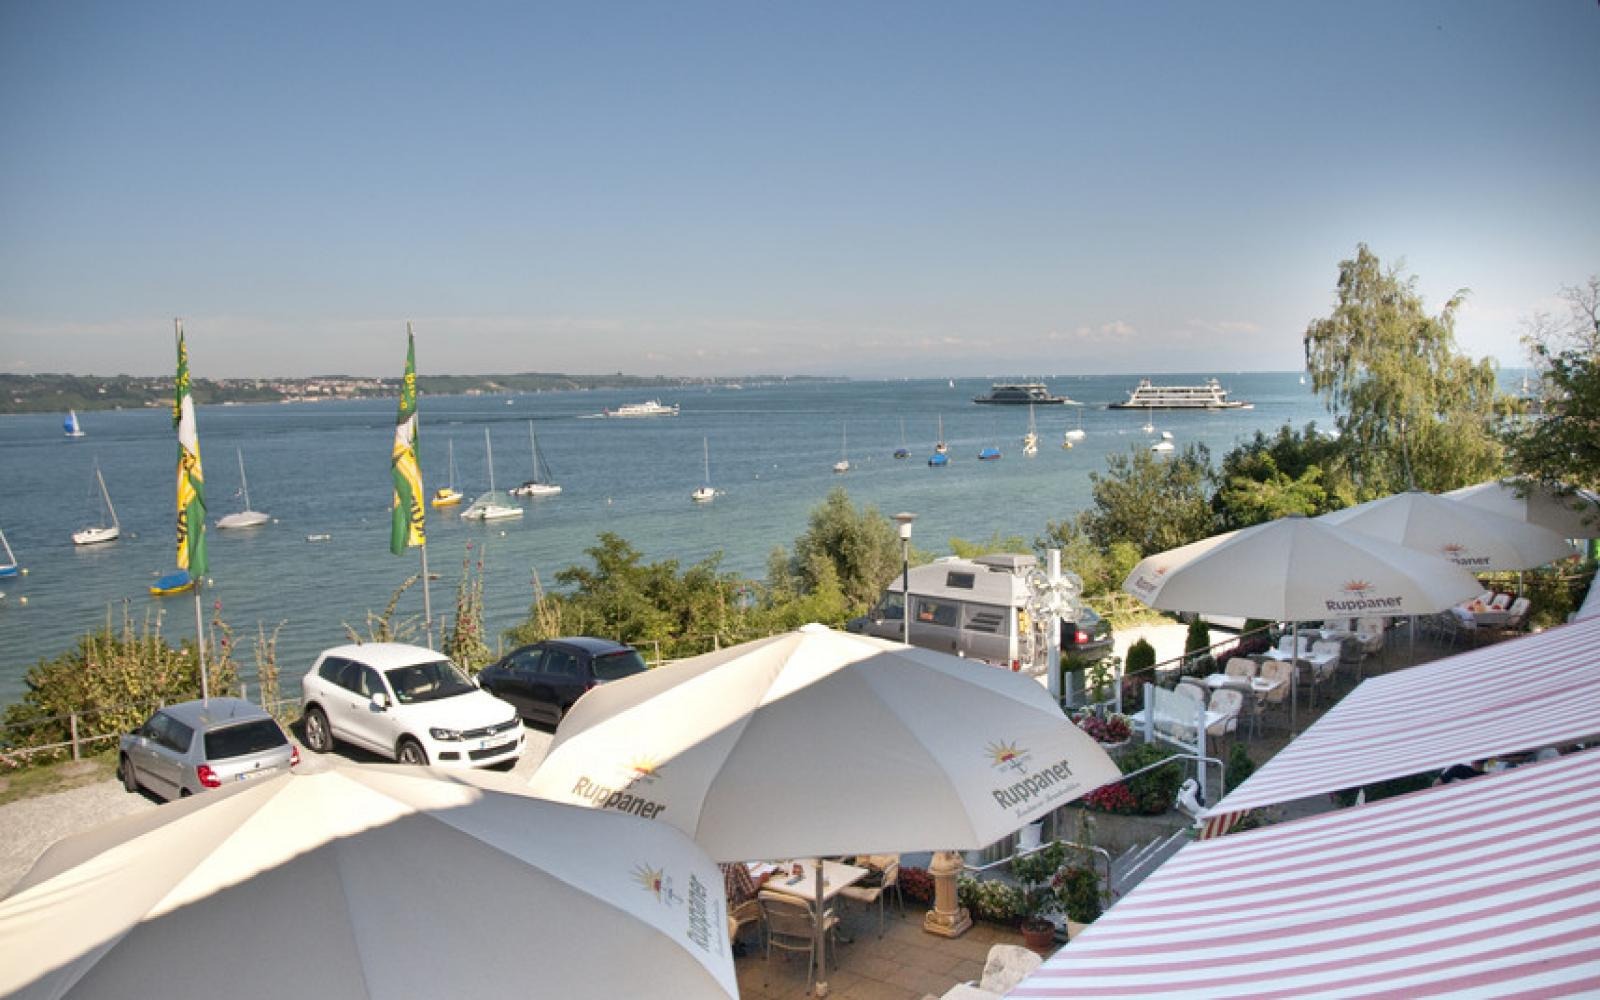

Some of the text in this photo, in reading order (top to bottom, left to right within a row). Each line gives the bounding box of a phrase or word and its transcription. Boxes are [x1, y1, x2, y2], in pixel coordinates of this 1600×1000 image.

[1326, 597, 1402, 610] Ruppaner
[572, 776, 666, 820] Ruppaner
[992, 760, 1073, 809] Ruppaner
